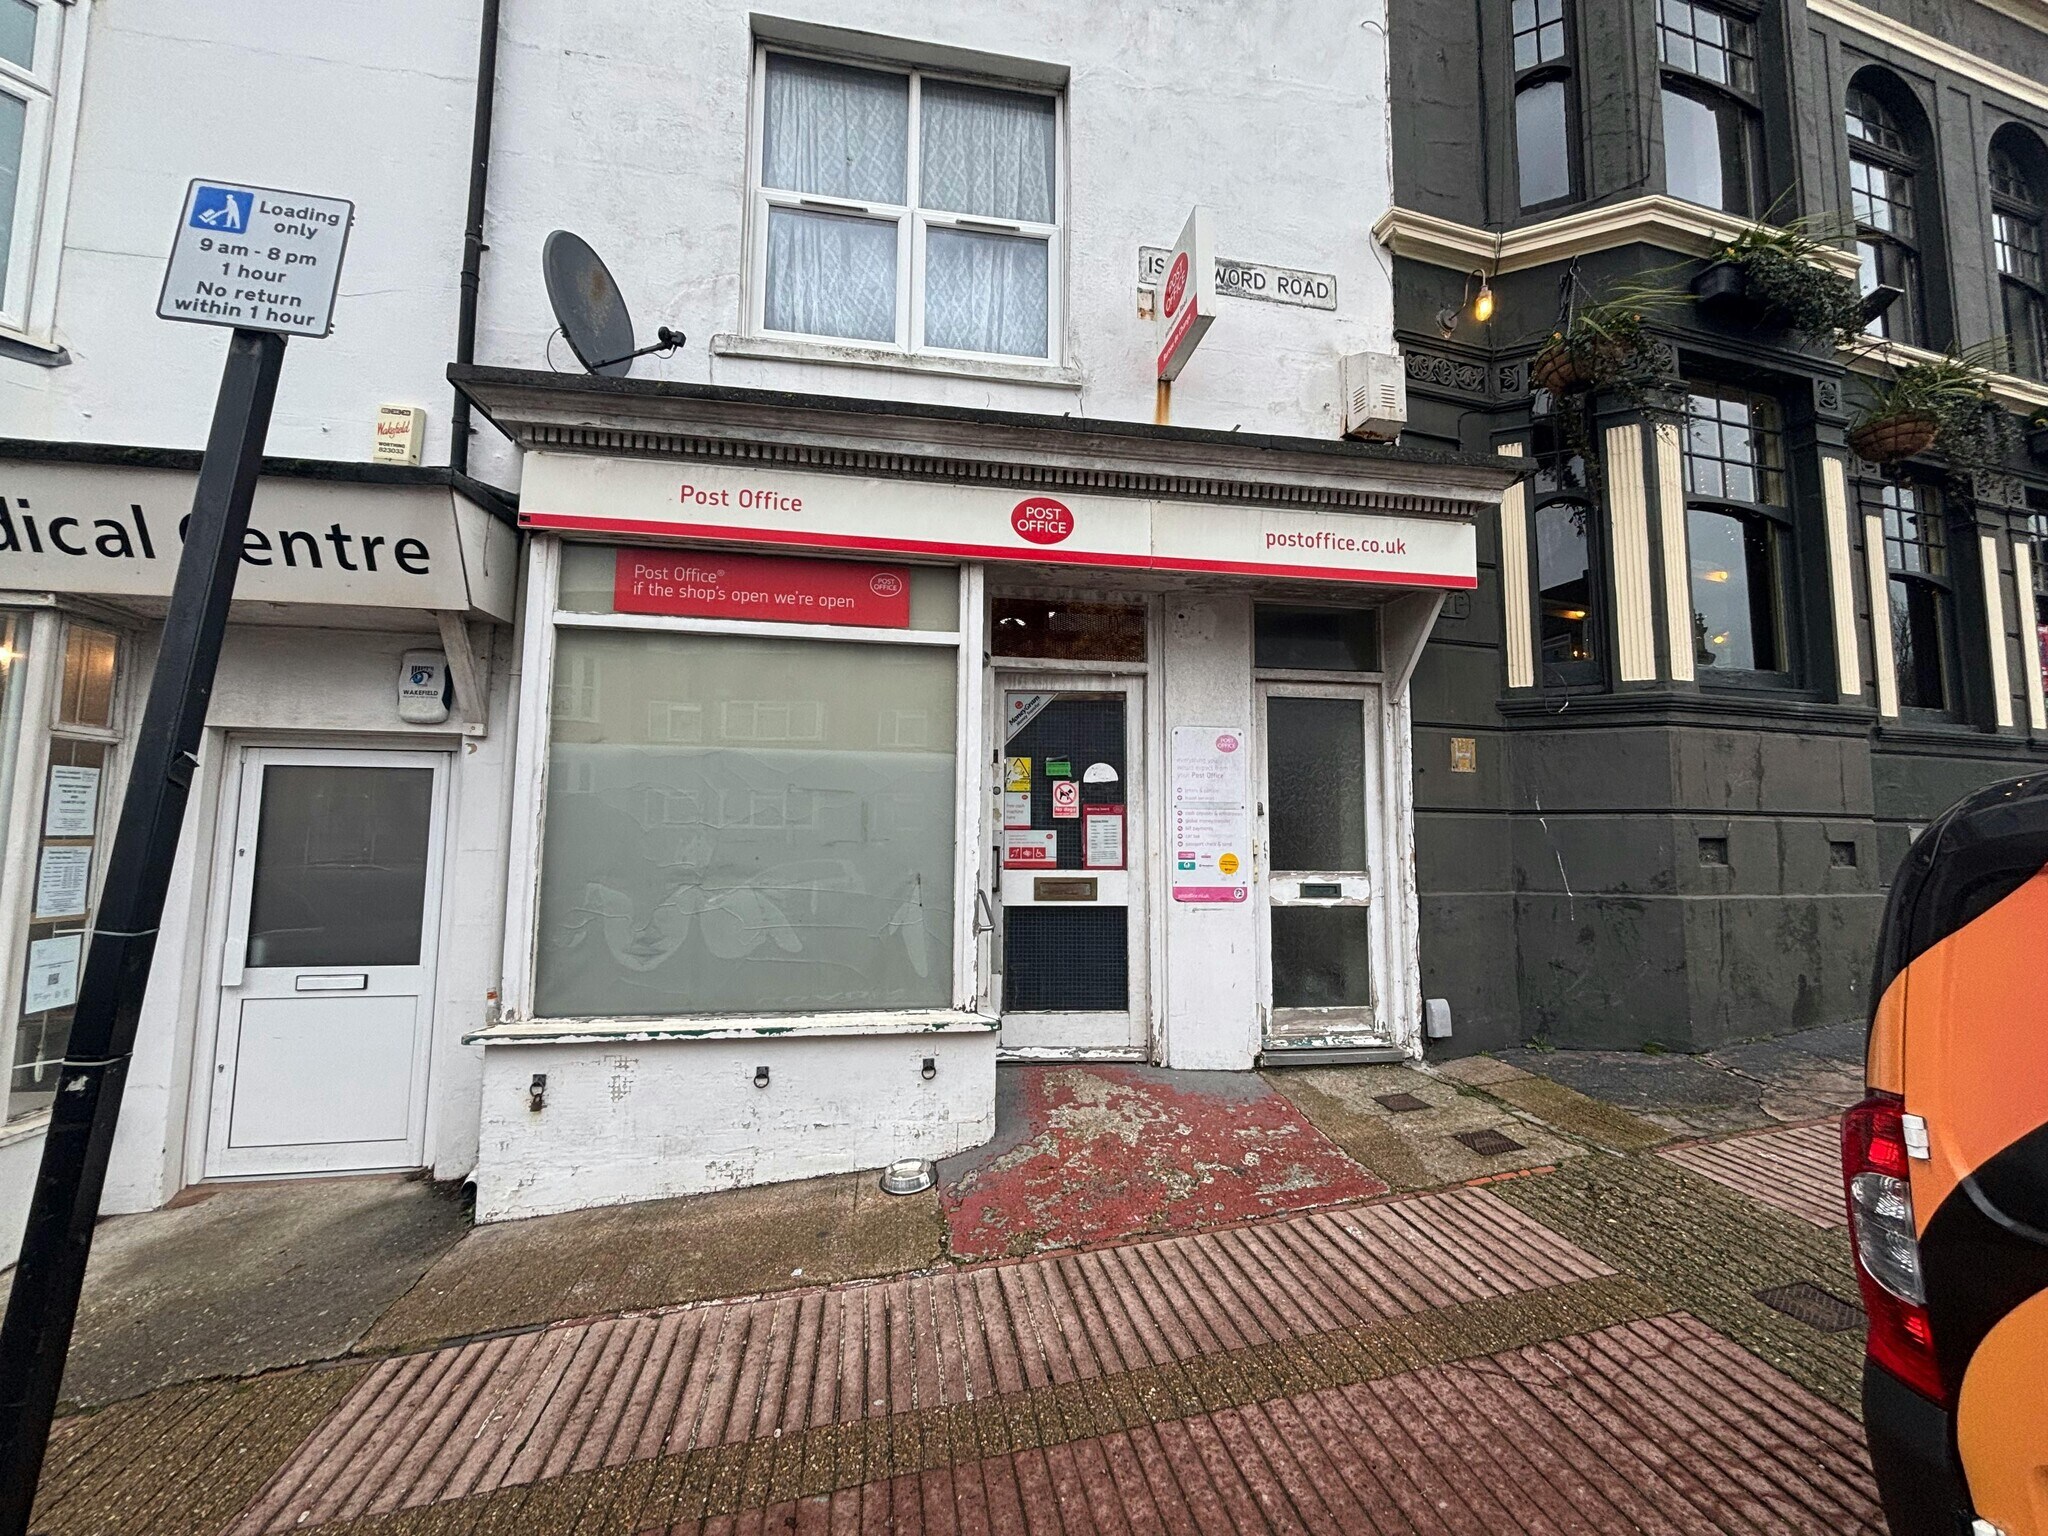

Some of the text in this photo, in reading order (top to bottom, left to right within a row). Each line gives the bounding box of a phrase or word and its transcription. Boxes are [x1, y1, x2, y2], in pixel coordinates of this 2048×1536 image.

[259, 201, 340, 226] Loading
[273, 222, 318, 240] only
[199, 238, 213, 252] 9
[218, 243, 249, 256] am
[267, 247, 281, 261] 8
[285, 252, 317, 266] pm
[222, 262, 286, 283] 1 hour
[1168, 260, 1184, 291] POST
[196, 281, 302, 307] No return
[1165, 271, 1186, 311] OFFICE
[1278, 277, 1328, 299] ROAD
[175, 298, 315, 326] within 1 hour
[377, 421, 410, 439] Wakefield
[680, 485, 802, 512] Post Office
[1026, 506, 1061, 520] POST
[1017, 518, 1067, 534] OFFICE
[179, 512, 430, 575] entre
[1266, 532, 1406, 555] postoffice.co.uk
[634, 564, 668, 581] Post
[633, 581, 855, 609] if the shop's open we're open
[874, 583, 897, 591] OFFICE
[1008, 695, 1040, 726] MoneyGram
